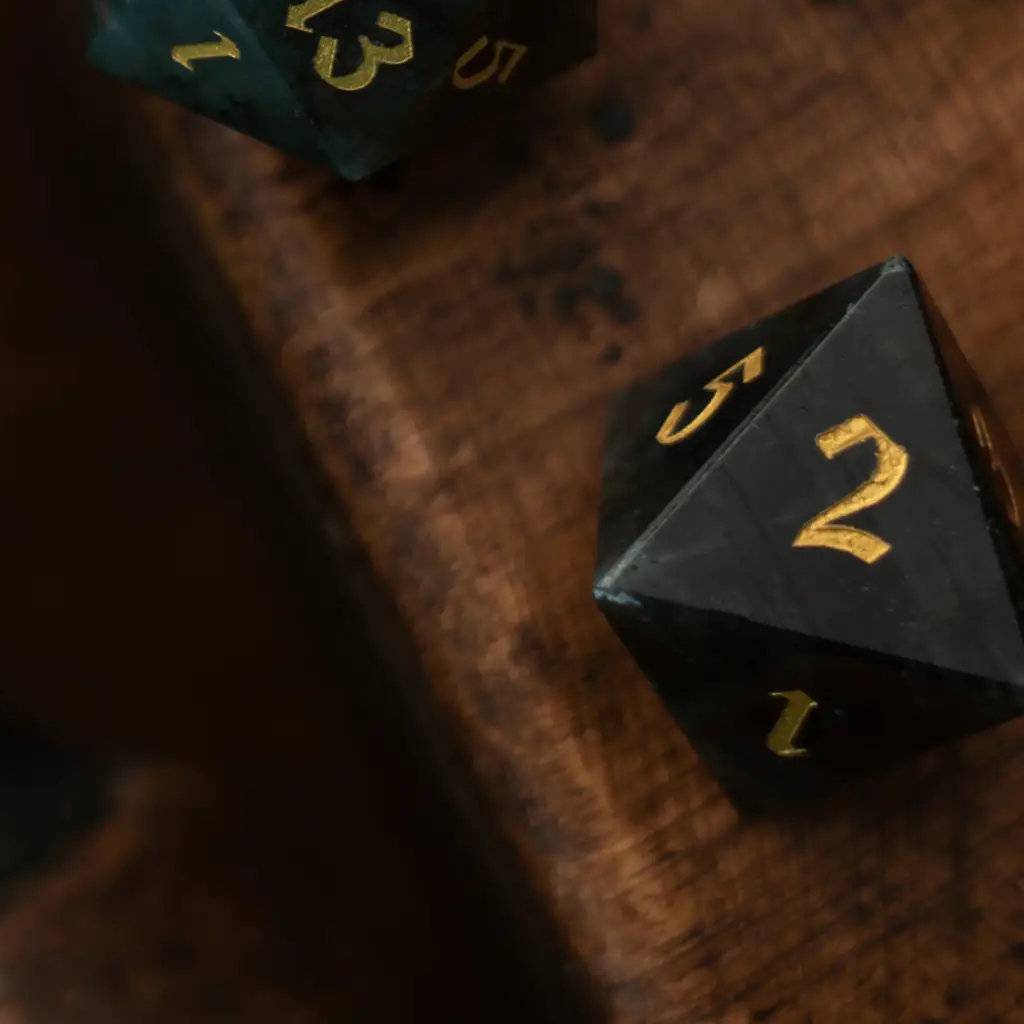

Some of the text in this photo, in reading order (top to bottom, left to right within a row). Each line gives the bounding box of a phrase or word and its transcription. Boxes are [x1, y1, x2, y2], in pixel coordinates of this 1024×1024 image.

[171, 31, 241, 71] 1
[451, 36, 527, 90] 5
[656, 345, 766, 446] 5
[791, 414, 909, 565] 2
[766, 688, 818, 758] 1
